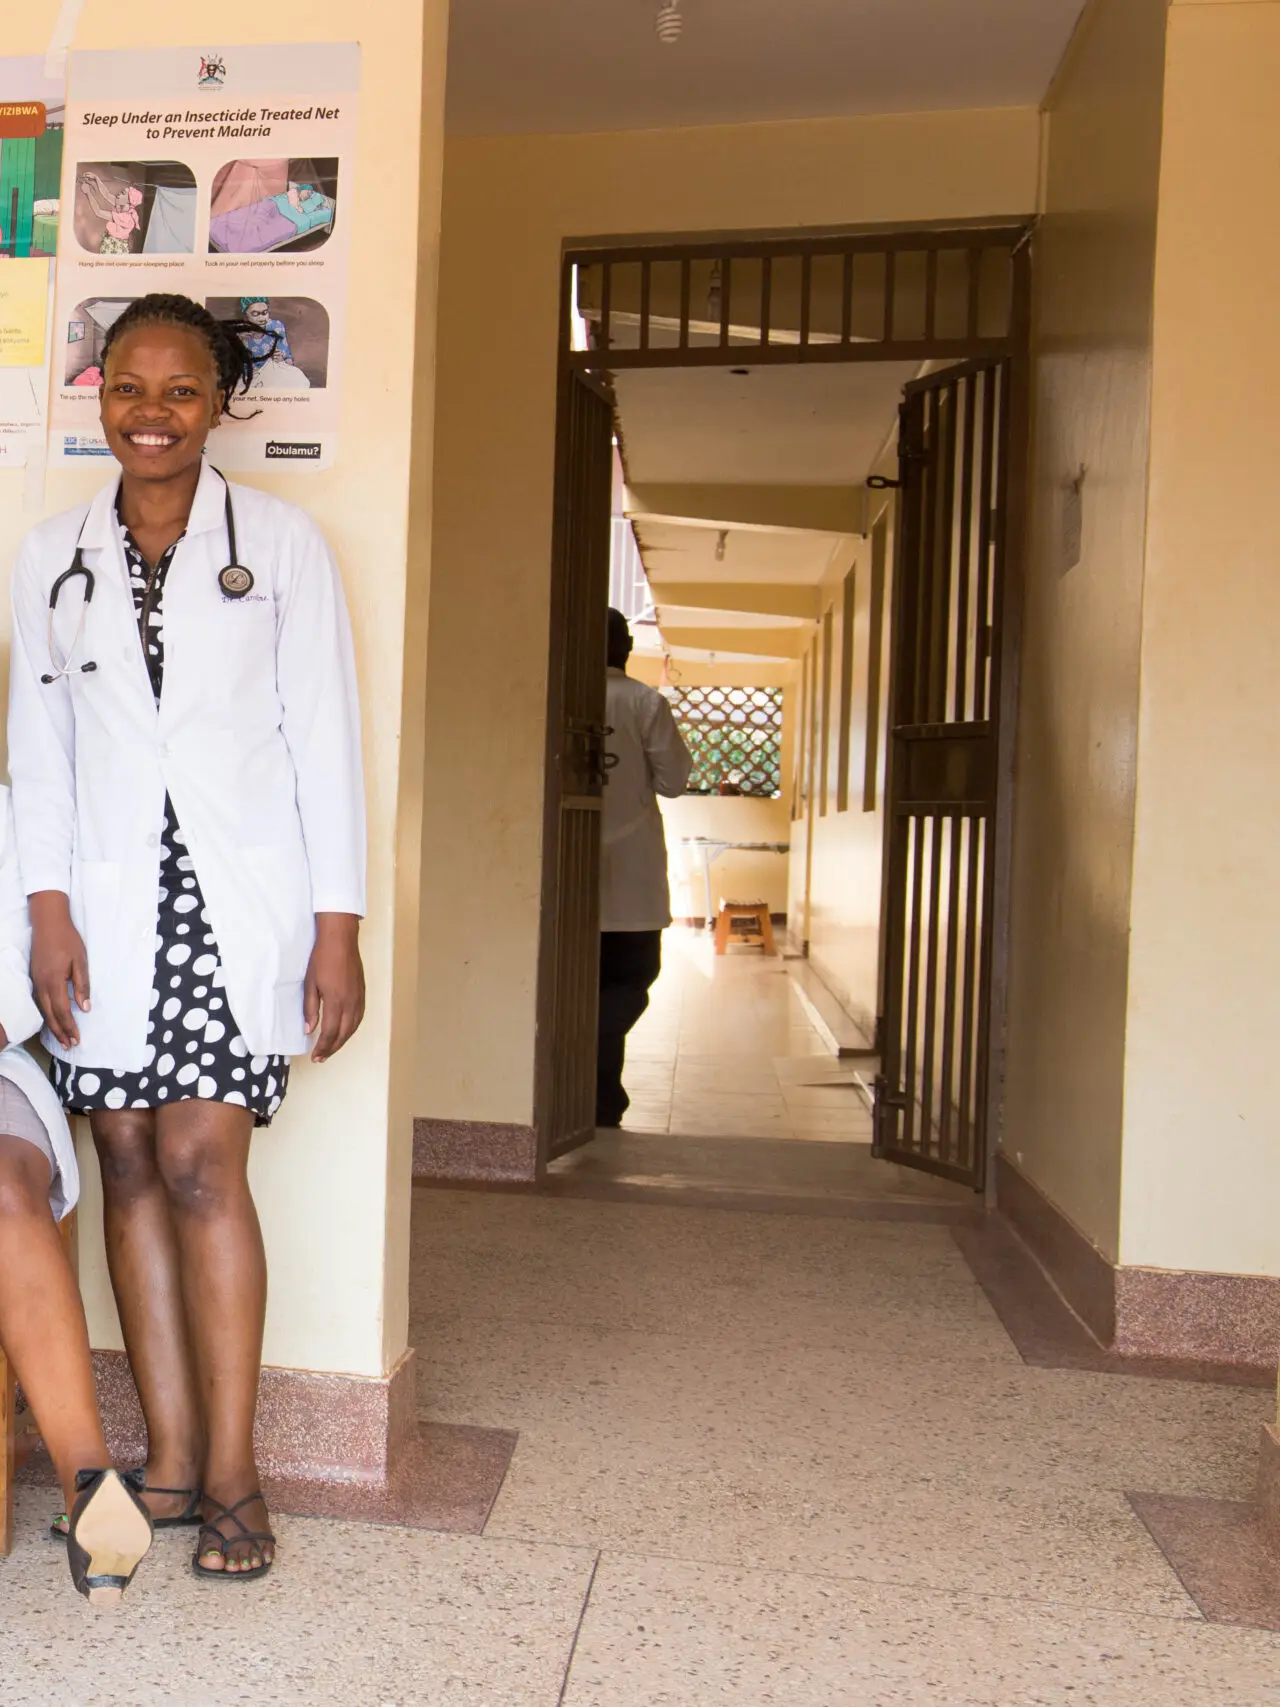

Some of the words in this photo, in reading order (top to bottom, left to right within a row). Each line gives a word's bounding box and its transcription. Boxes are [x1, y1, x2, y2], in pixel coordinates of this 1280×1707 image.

[82, 112, 118, 127] Sleep
[121, 111, 162, 125] Under
[164, 113, 181, 124] an
[184, 109, 257, 123] Insecticide
[260, 108, 311, 122] Treated
[315, 107, 340, 120] Net
[146, 127, 159, 139] to
[162, 126, 215, 139] Prevent
[217, 125, 271, 138] Malaria
[267, 445, 319, 456] Obulamu?
